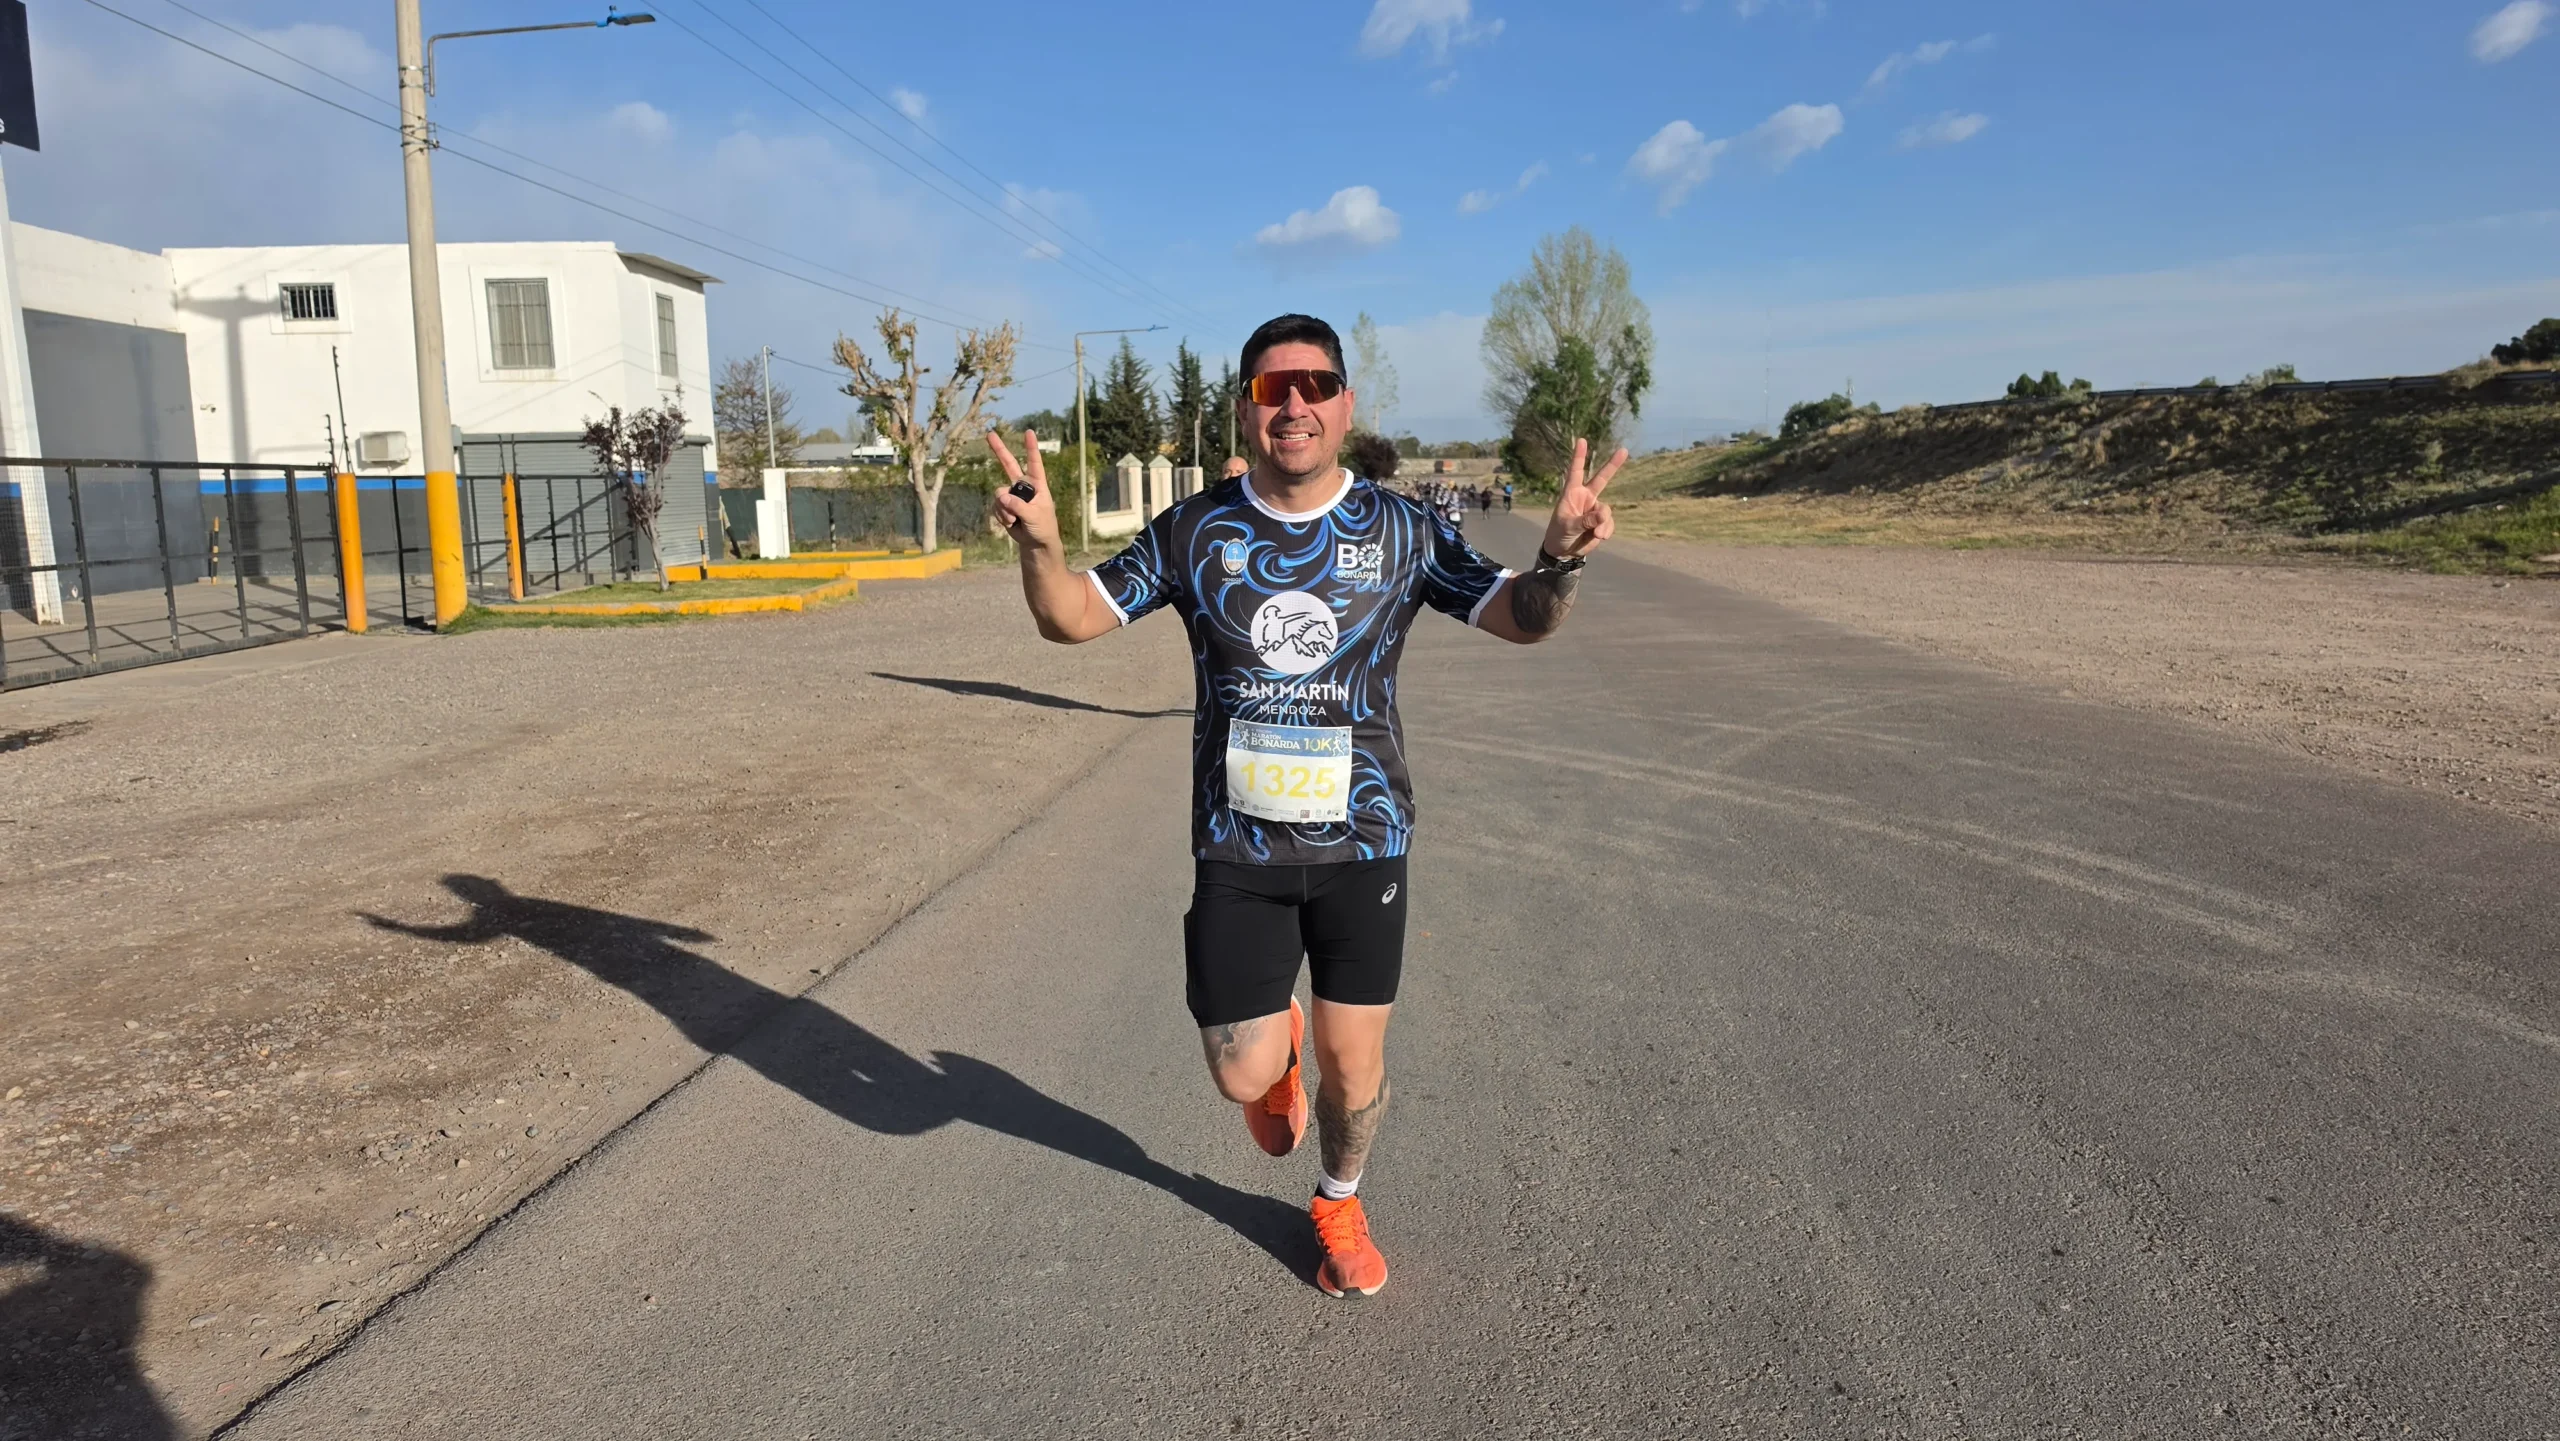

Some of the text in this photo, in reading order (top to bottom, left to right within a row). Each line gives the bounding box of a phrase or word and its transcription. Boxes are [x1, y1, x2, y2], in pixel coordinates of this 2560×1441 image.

[1337, 570, 1382, 580] BONARDA
[1239, 680, 1350, 701] SAN MARTÍN
[1259, 704, 1327, 716] MENDOZA
[1251, 731, 1282, 741] MARATÓN
[1250, 736, 1333, 752] BONARDA 10K
[1240, 760, 1337, 799] 1325
